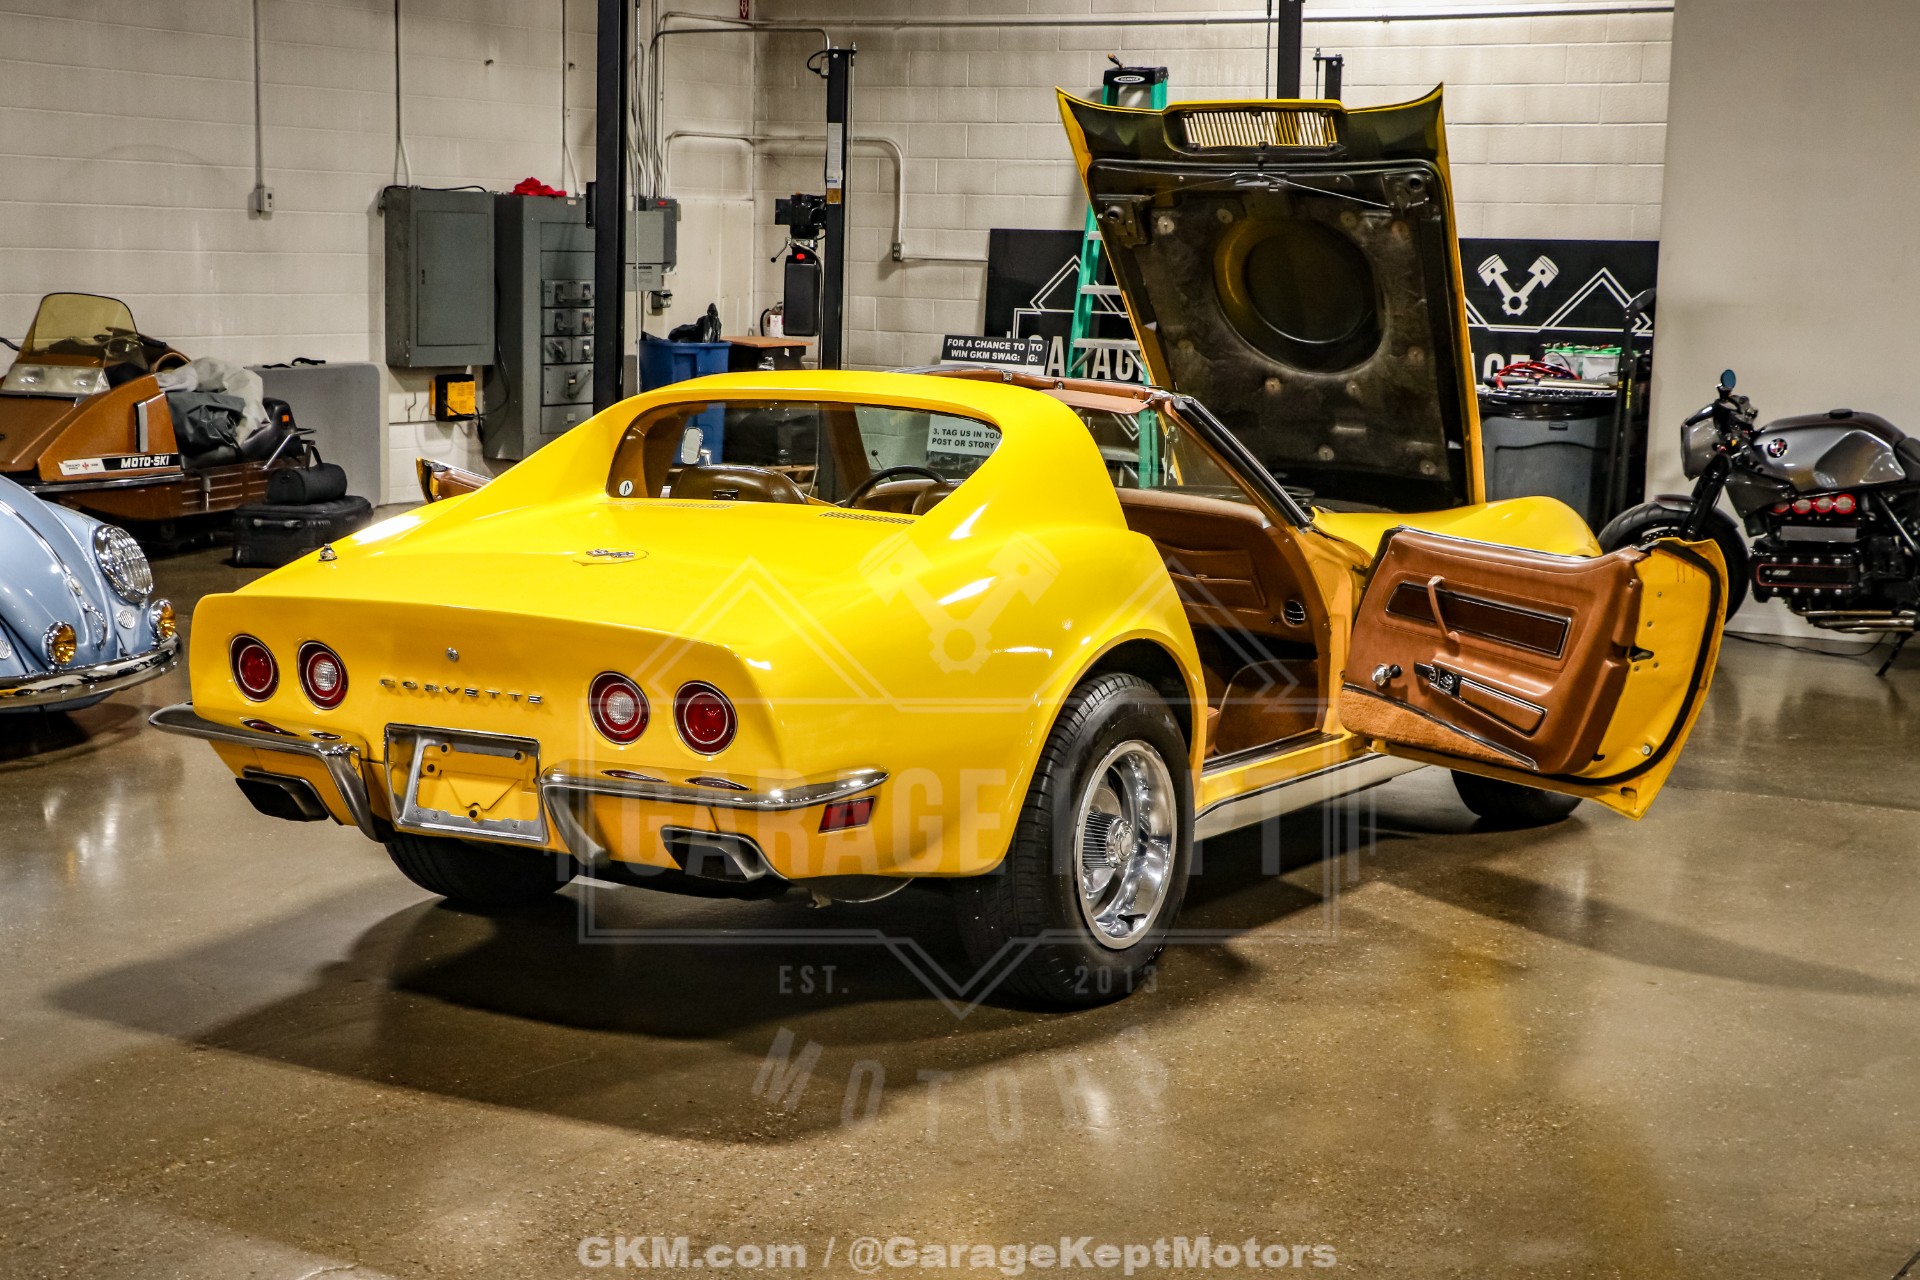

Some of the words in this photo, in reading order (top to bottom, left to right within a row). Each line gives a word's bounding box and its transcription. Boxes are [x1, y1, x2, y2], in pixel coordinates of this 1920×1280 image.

[947, 338, 965, 347] FOR
[966, 340, 973, 348] A
[974, 340, 1011, 350] CHANCE
[1012, 342, 1026, 351] TO
[1031, 343, 1043, 352] TO
[951, 349, 968, 358] WIN
[969, 351, 990, 360] GKM
[991, 352, 1021, 362] SWAG:
[942, 428, 958, 436] TAG
[973, 430, 982, 438] IN
[932, 437, 952, 446] POST
[954, 439, 966, 447] OR
[968, 440, 995, 449] STORY
[379, 678, 544, 704] CORVETTE
